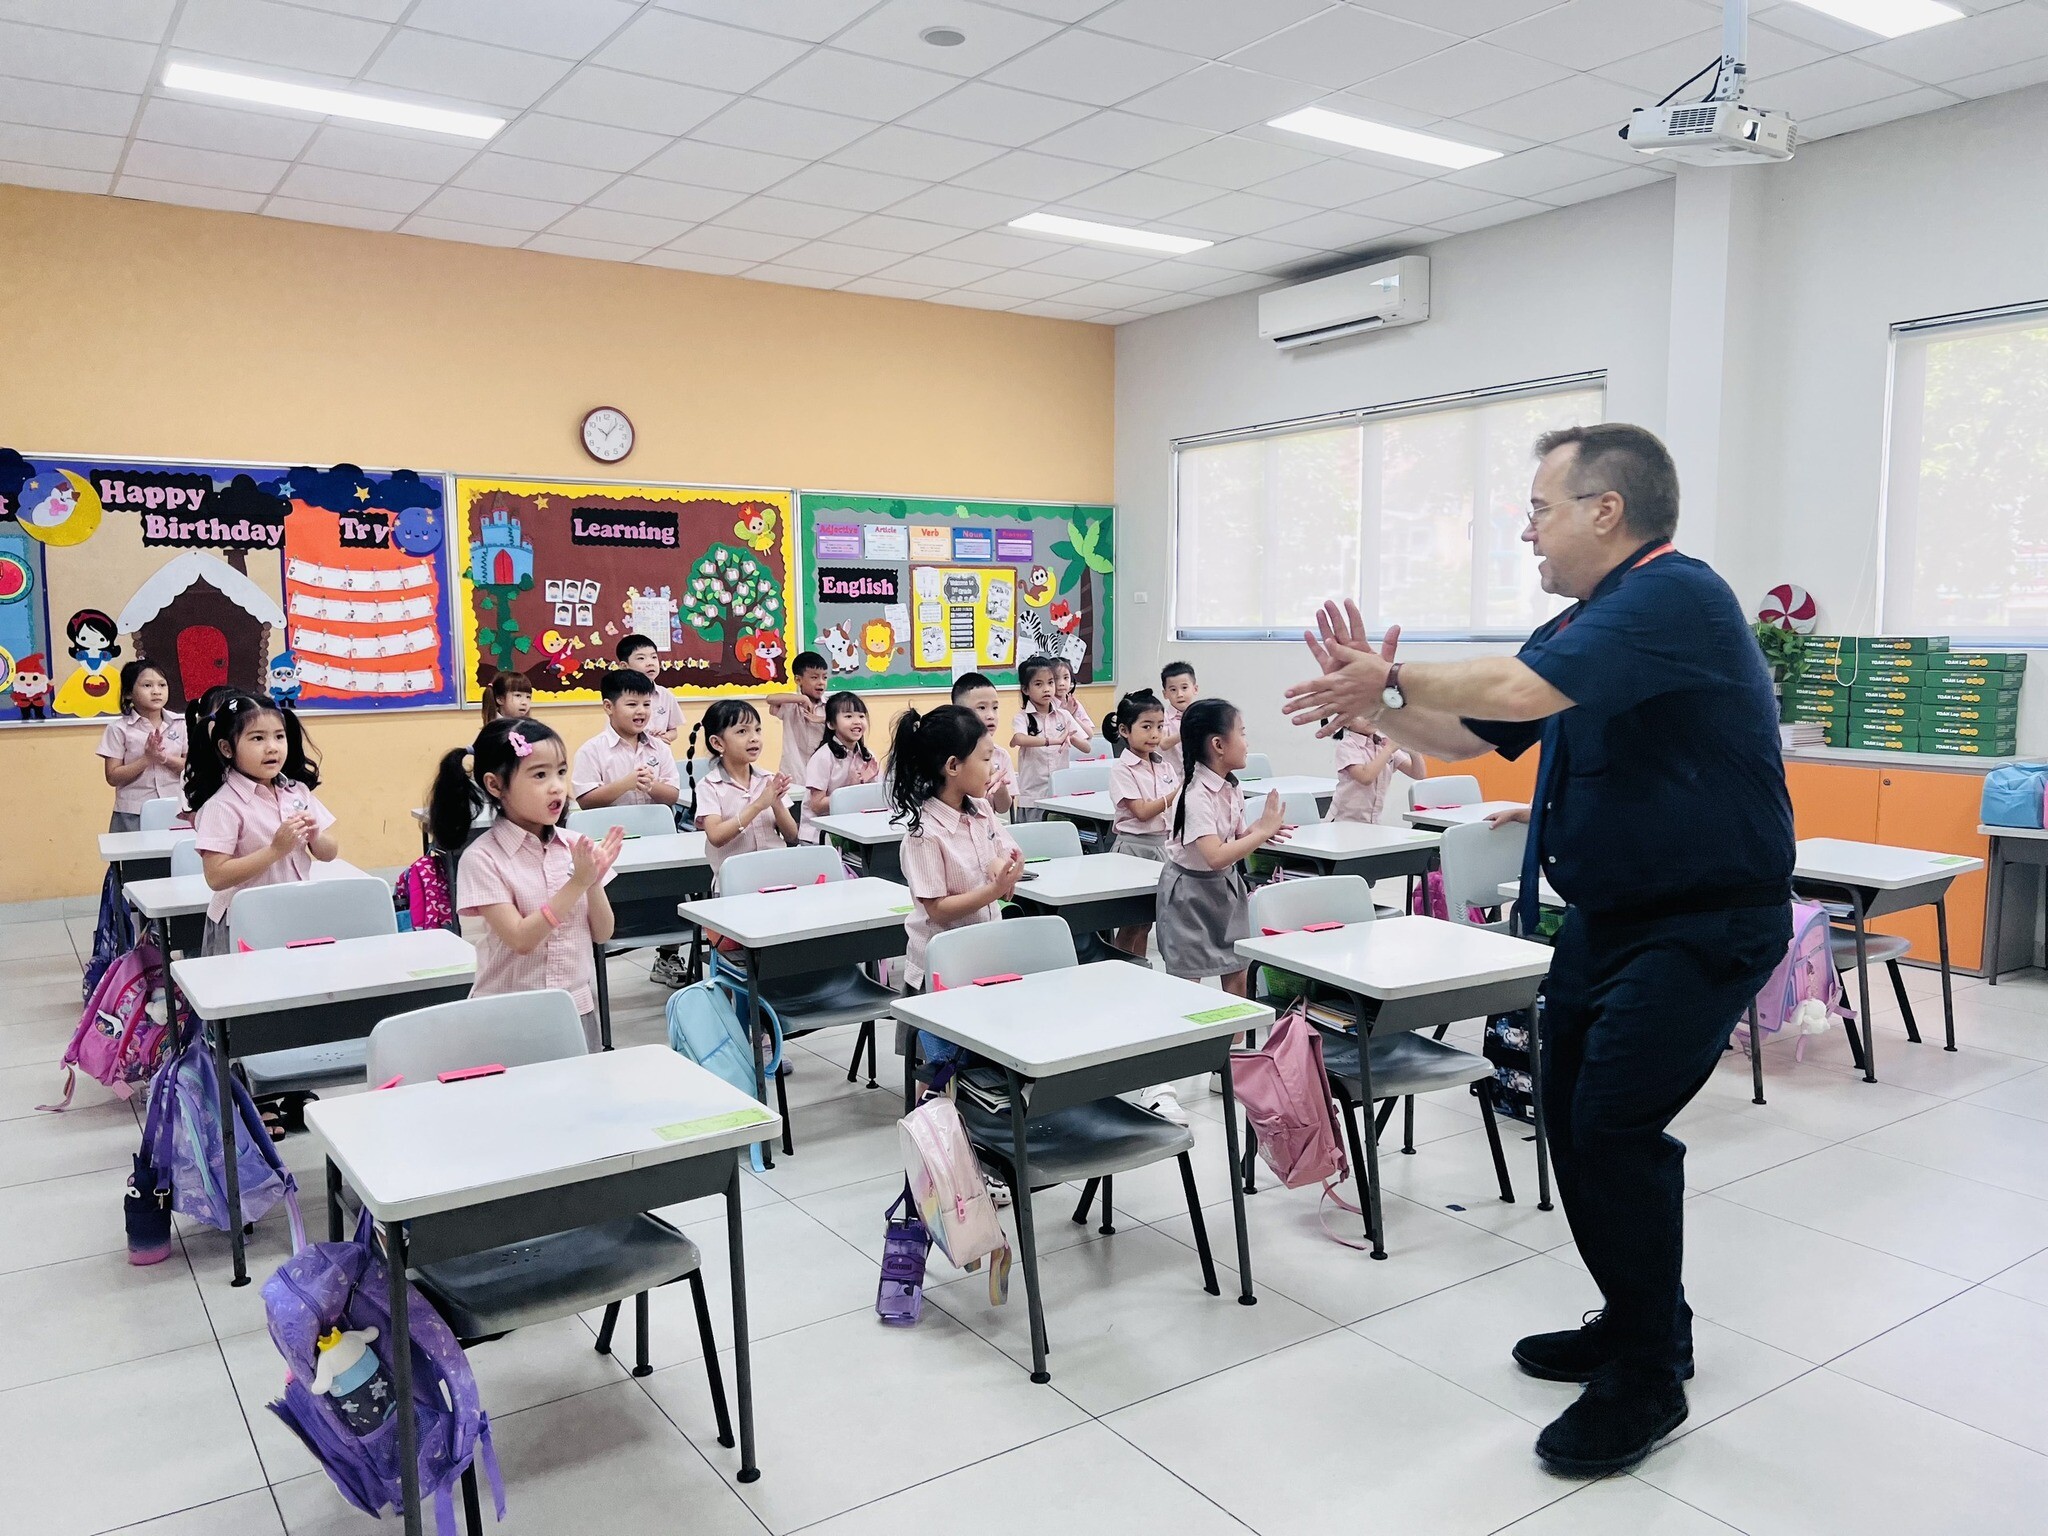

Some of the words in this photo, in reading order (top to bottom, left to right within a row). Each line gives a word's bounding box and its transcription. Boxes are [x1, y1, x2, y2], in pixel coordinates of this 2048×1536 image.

[100, 479, 206, 511] Happy
[146, 515, 284, 546] Birthday
[340, 518, 390, 544] Try
[574, 517, 676, 546] Learning
[819, 524, 858, 535] Adjective
[875, 526, 897, 534] Article
[921, 528, 940, 537] Verb
[962, 530, 984, 538] Noun
[821, 575, 894, 598] English
